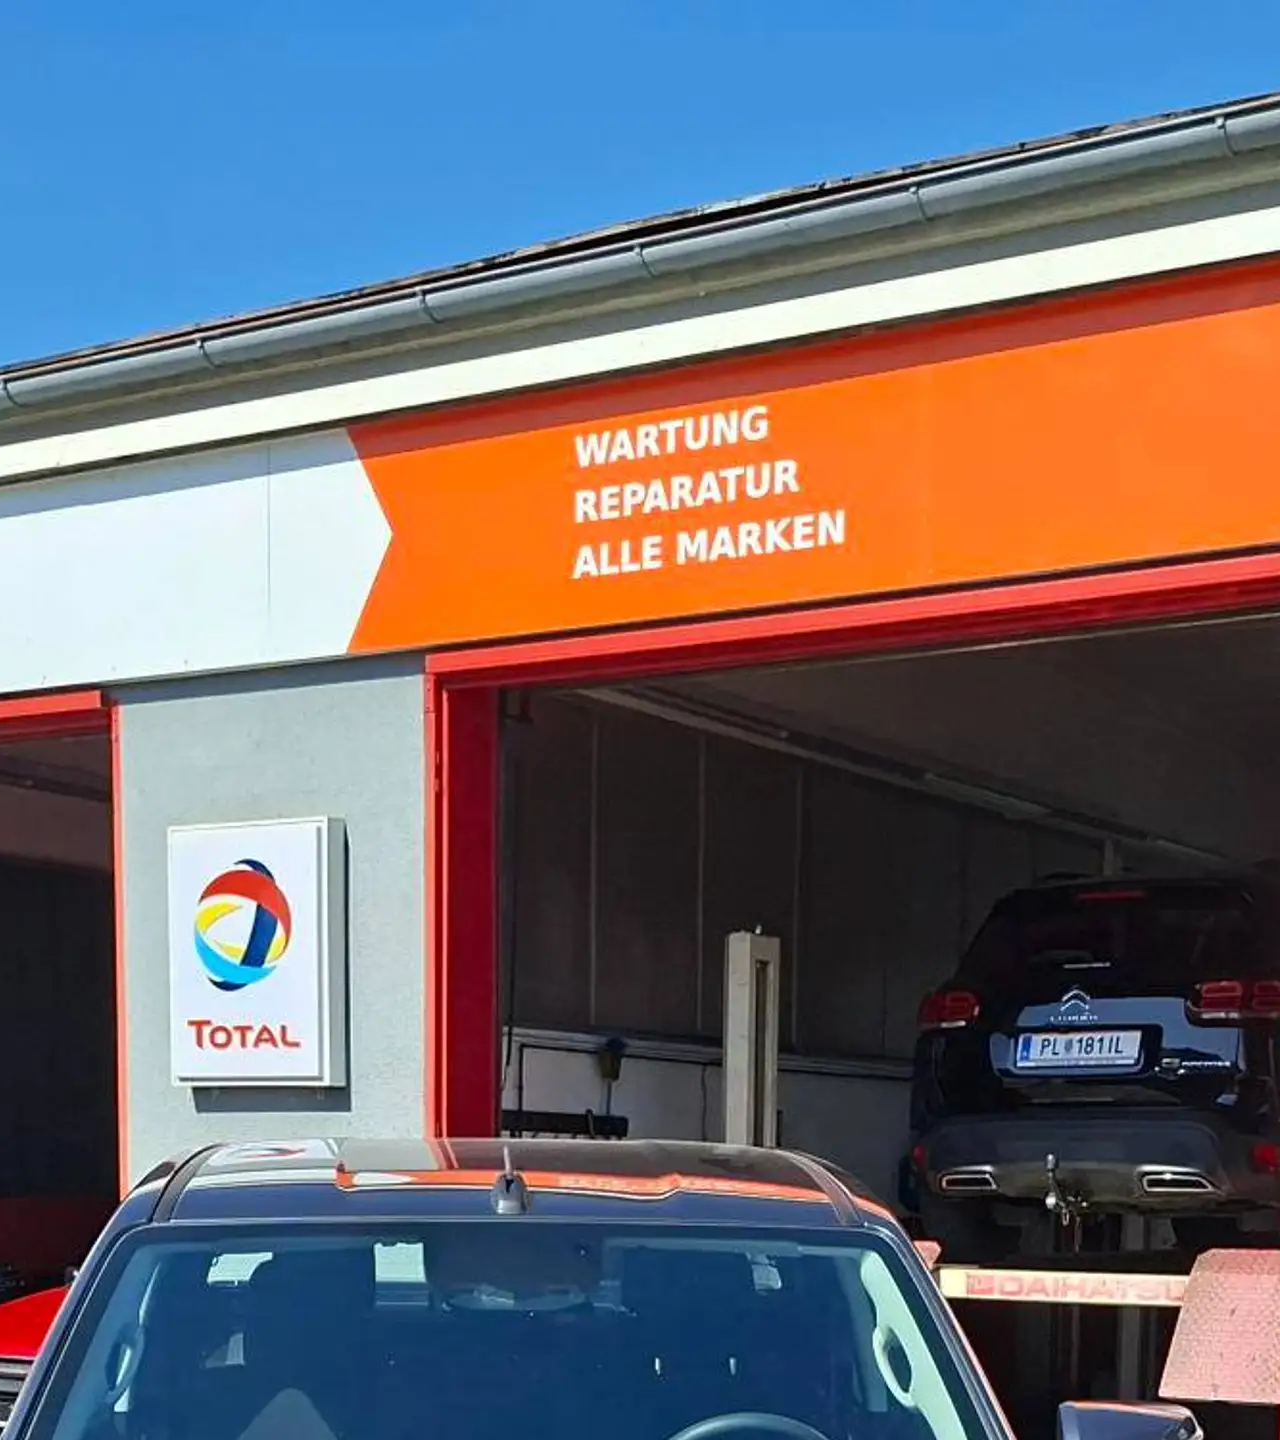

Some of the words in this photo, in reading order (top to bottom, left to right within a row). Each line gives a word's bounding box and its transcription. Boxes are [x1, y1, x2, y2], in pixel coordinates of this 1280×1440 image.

[574, 405, 768, 468] WARTUNG
[574, 459, 800, 523] REPARATUR
[572, 535, 663, 579] ALLE
[676, 509, 846, 565] MARKEN
[187, 1019, 301, 1050] TOTAL
[1039, 1037, 1060, 1057] PL
